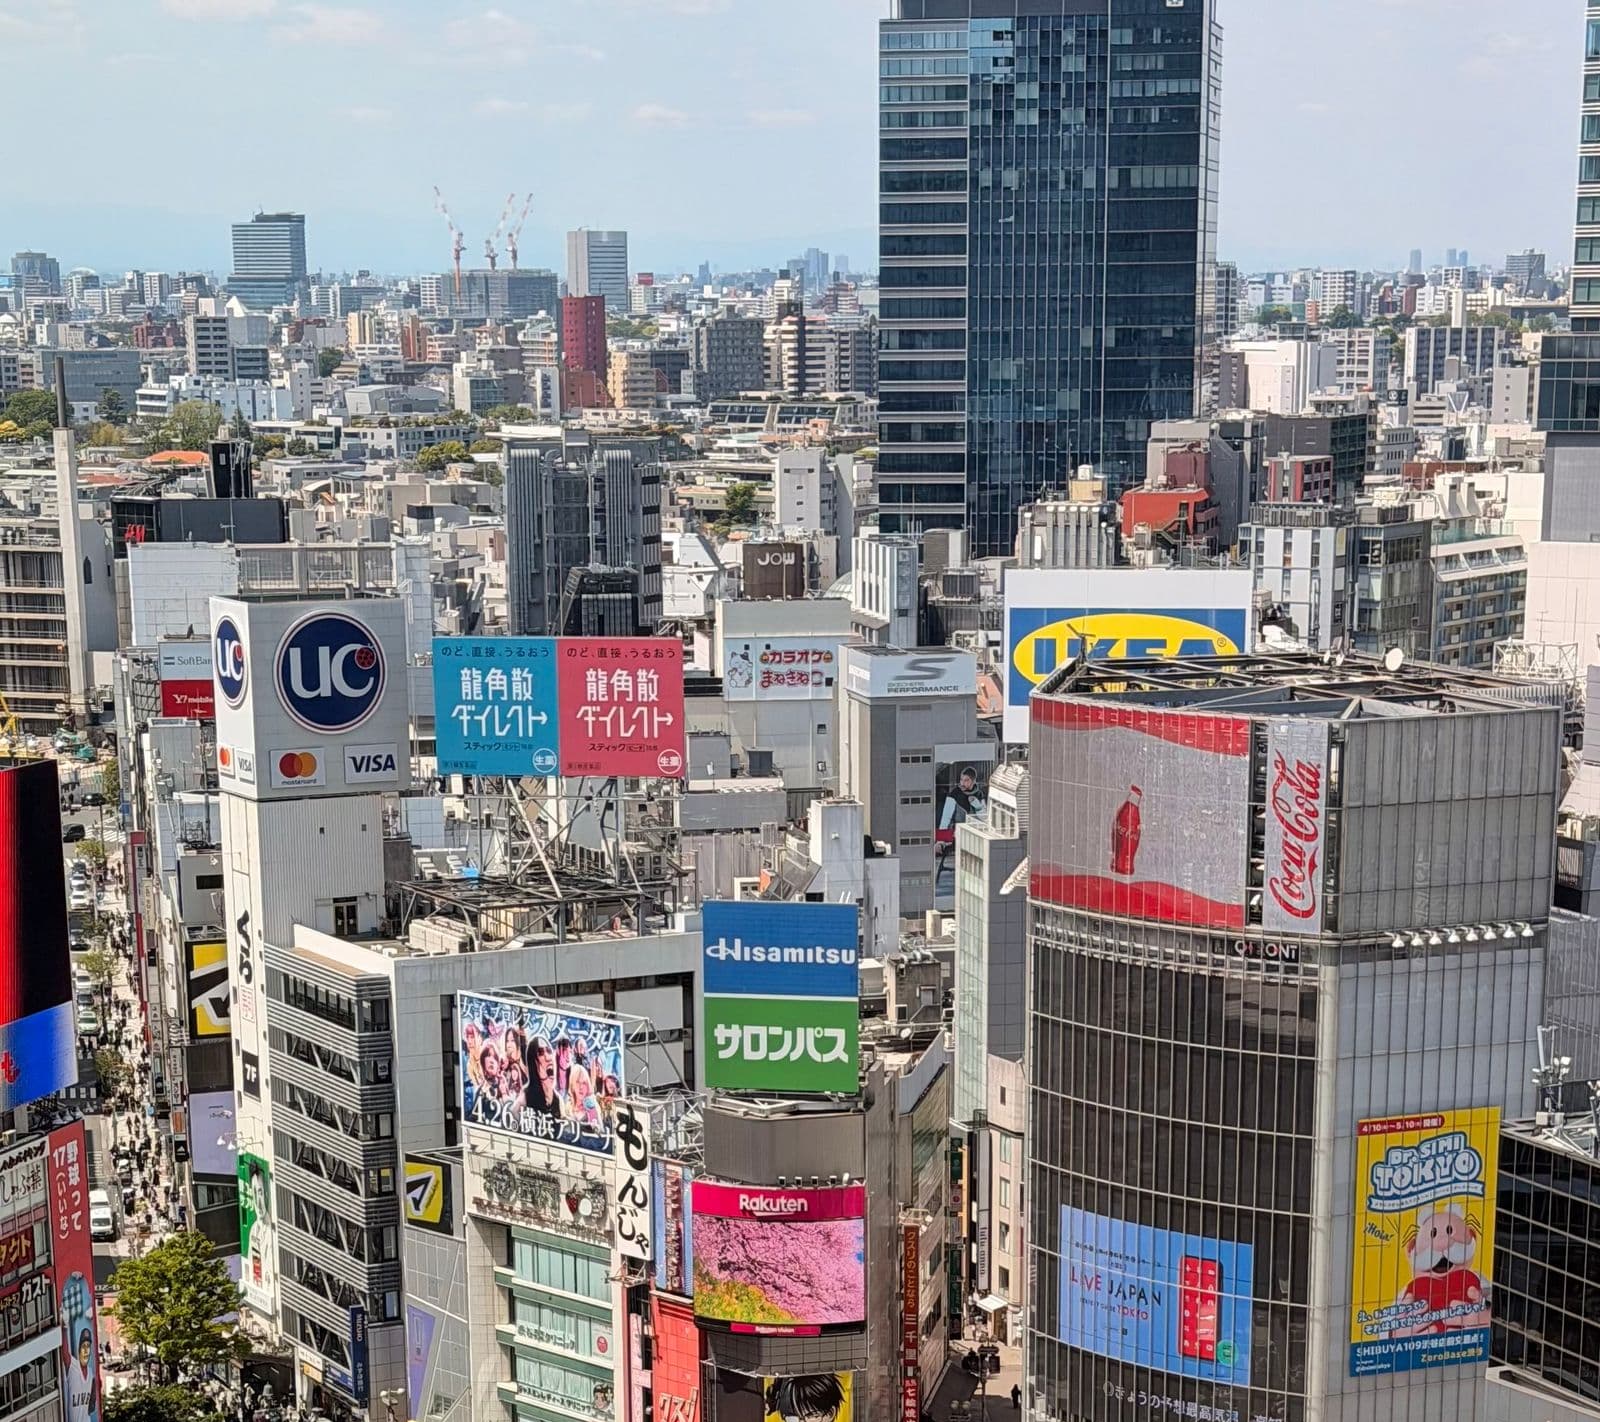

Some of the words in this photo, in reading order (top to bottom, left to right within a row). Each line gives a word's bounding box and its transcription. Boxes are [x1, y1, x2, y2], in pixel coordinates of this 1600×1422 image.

[177, 656, 213, 666] SoftBan
[217, 638, 245, 682] UC
[441, 646, 550, 659] のど、直接、うるおう
[567, 646, 676, 660] のど、直接、うるおう
[768, 650, 825, 664] カラオケ
[289, 643, 375, 699] UC
[460, 667, 533, 701] 龍角散
[585, 668, 659, 702] 龍角散
[760, 670, 824, 688] まねきねこ
[887, 685, 960, 694] PERFORMANCE
[451, 705, 548, 737] ダイレクト
[576, 706, 673, 738] ダイレクト
[348, 754, 396, 773] VISA
[1268, 749, 1321, 920] Coca-Cola
[706, 938, 856, 964] Hisamitsu
[1234, 940, 1298, 959] QONT
[535, 1013, 622, 1052] スターダム
[714, 1023, 849, 1063] サロンパス
[245, 1063, 257, 1083] 7F
[519, 1106, 616, 1150] 横浜アリーナ
[1389, 1149, 1419, 1165] Dr.
[1420, 1134, 1463, 1158] SIMI
[615, 1104, 651, 1256] もんじゃ
[1375, 1151, 1476, 1191] TOKYO
[739, 1194, 808, 1213] Rakuten
[22, 1273, 50, 1304] ガスト
[1108, 1278, 1162, 1307] JAPAN
